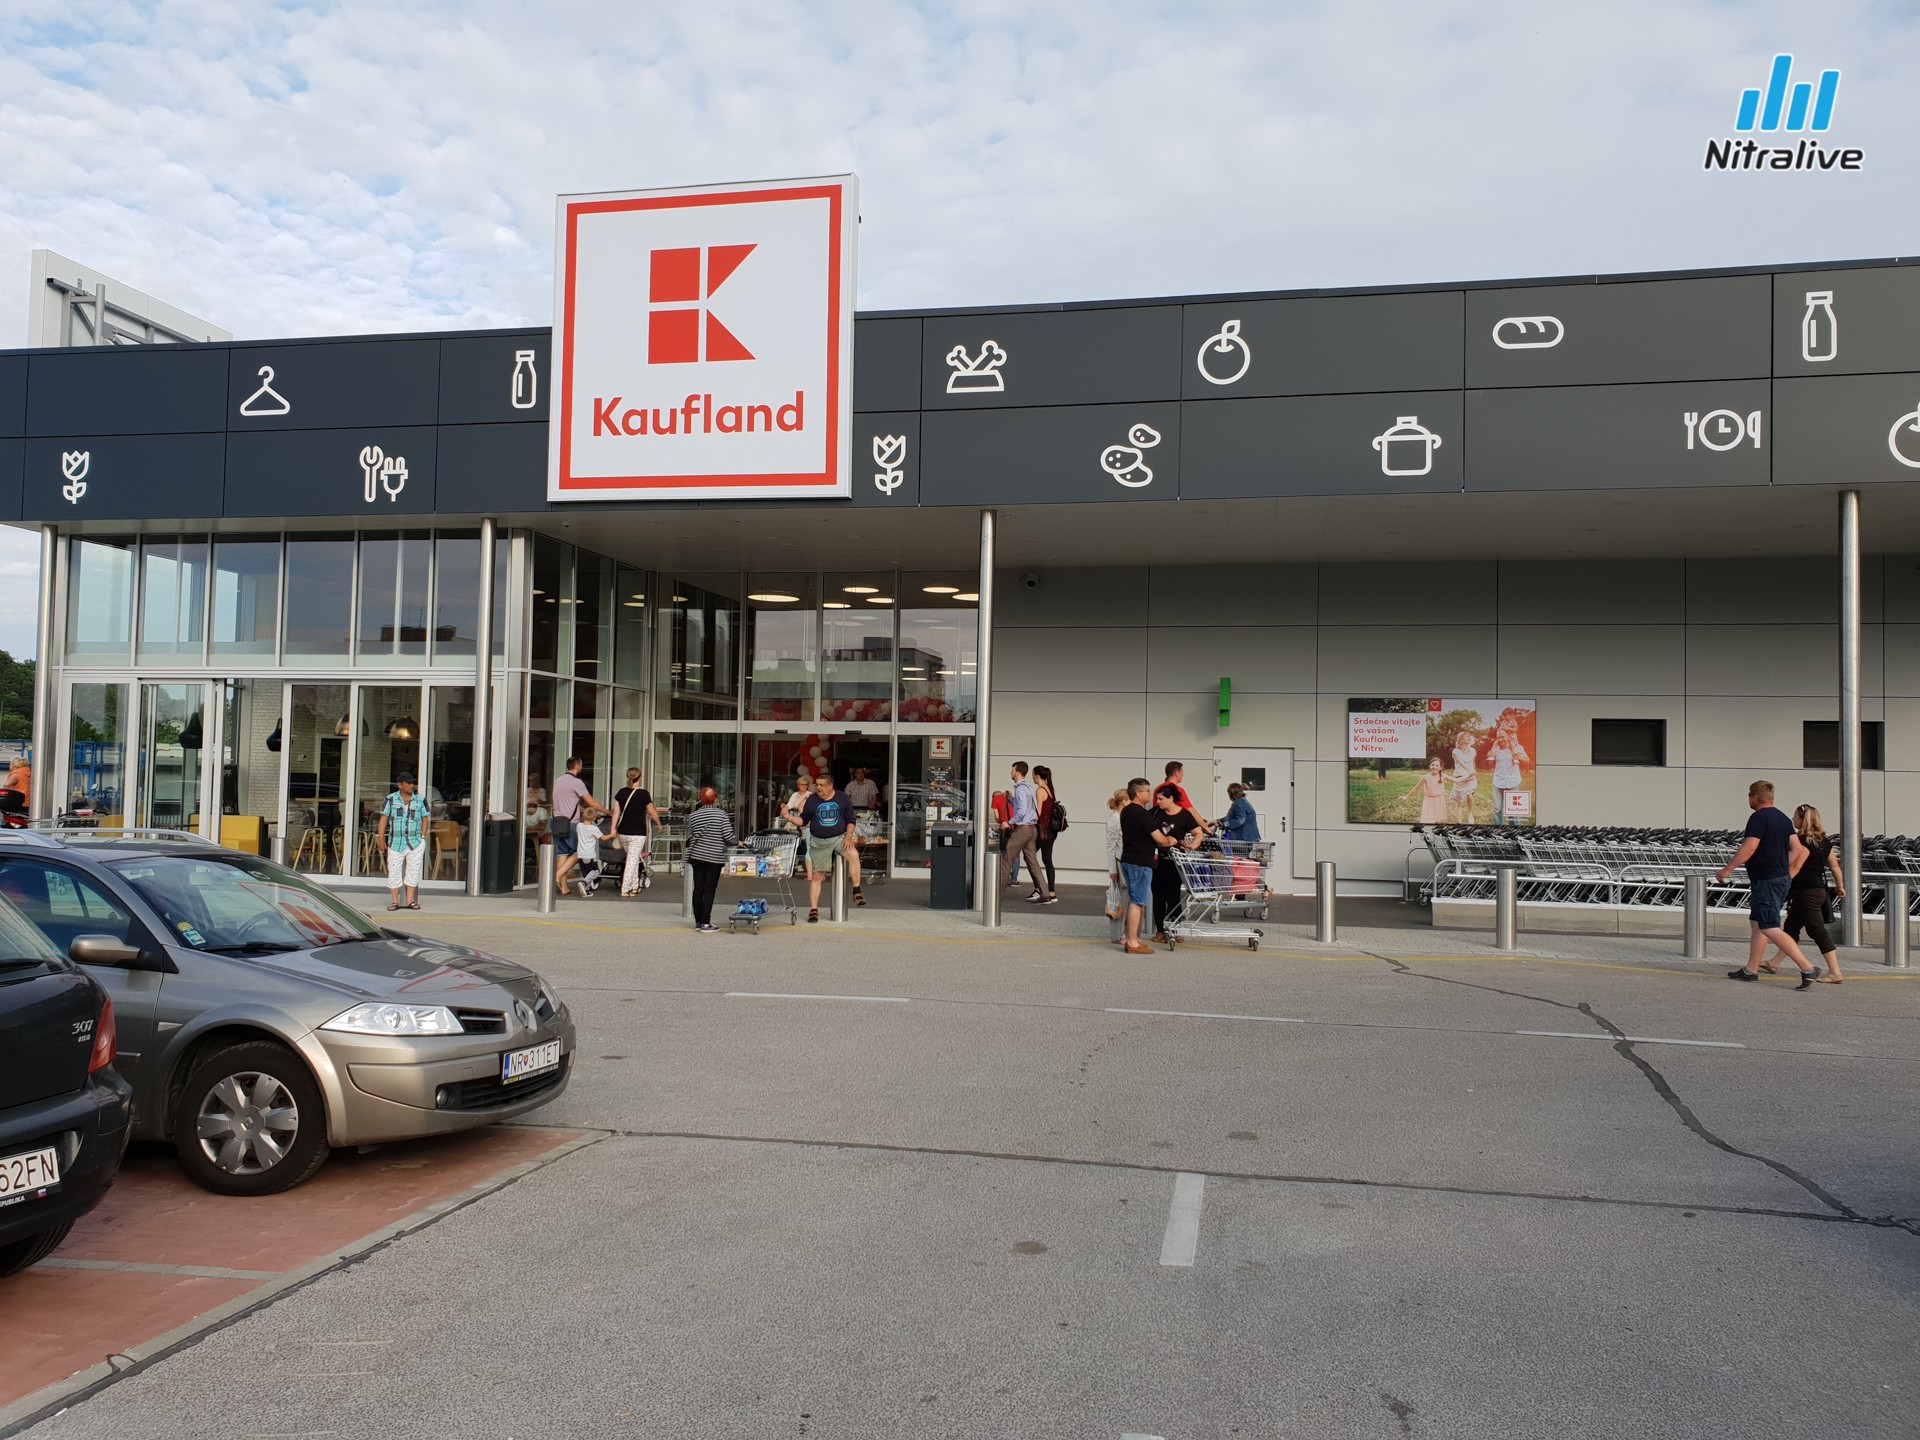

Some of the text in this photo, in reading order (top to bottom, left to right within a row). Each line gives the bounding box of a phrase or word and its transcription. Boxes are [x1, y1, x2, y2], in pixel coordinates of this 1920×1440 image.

[592, 390, 804, 437] Kaufland
[1353, 717, 1421, 727] Srdečne vitajte
[1366, 726, 1395, 734] vašom
[1353, 735, 1399, 743] Kauflande
[1361, 744, 1386, 752] Nitre.
[71, 1019, 94, 1035] 307
